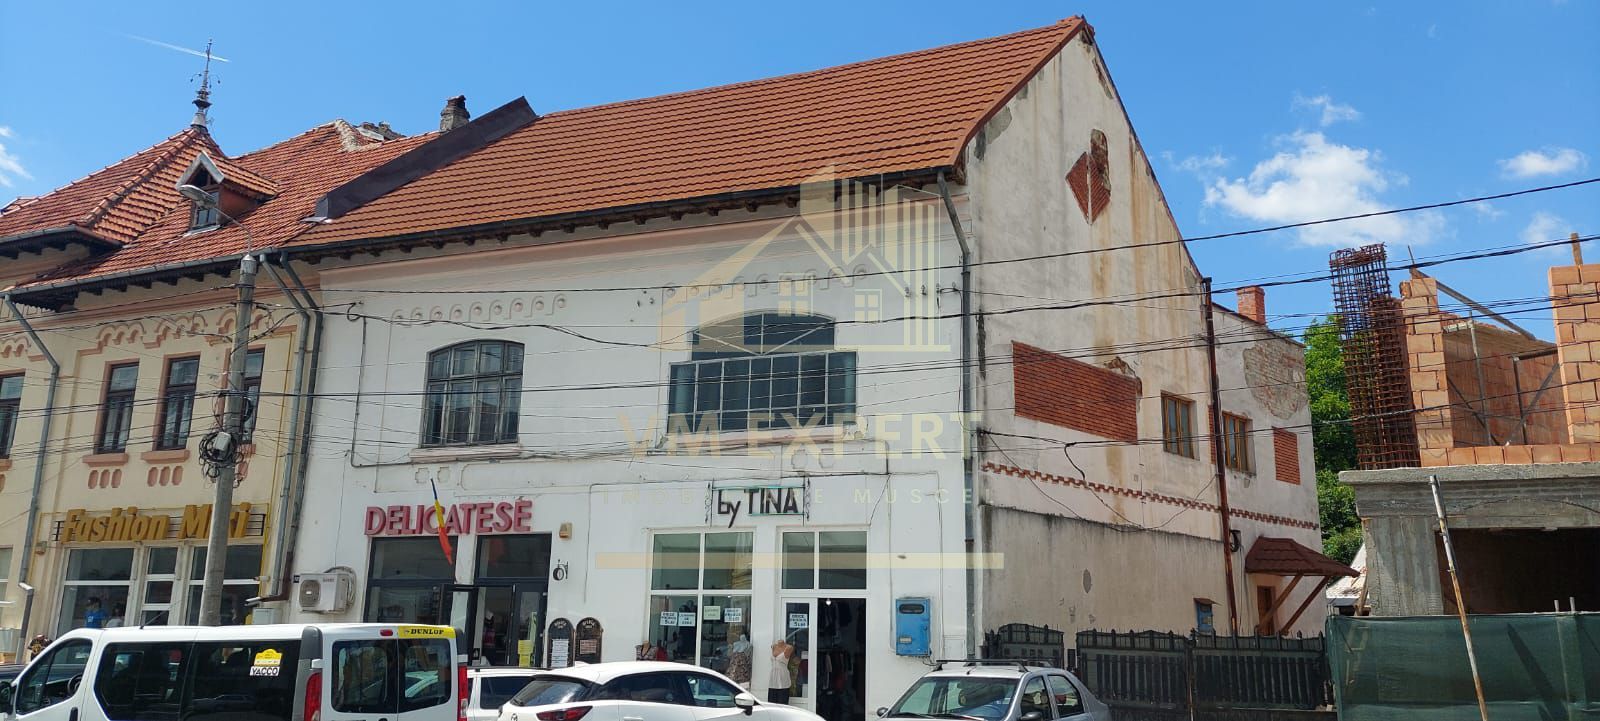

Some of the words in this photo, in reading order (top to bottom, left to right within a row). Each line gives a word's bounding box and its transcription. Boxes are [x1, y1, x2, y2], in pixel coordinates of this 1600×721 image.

[61, 506, 171, 544] Fashion
[364, 500, 533, 535] DELICATESE
[717, 489, 741, 528] by
[744, 487, 799, 514] TINA
[251, 666, 279, 675] YACCO
